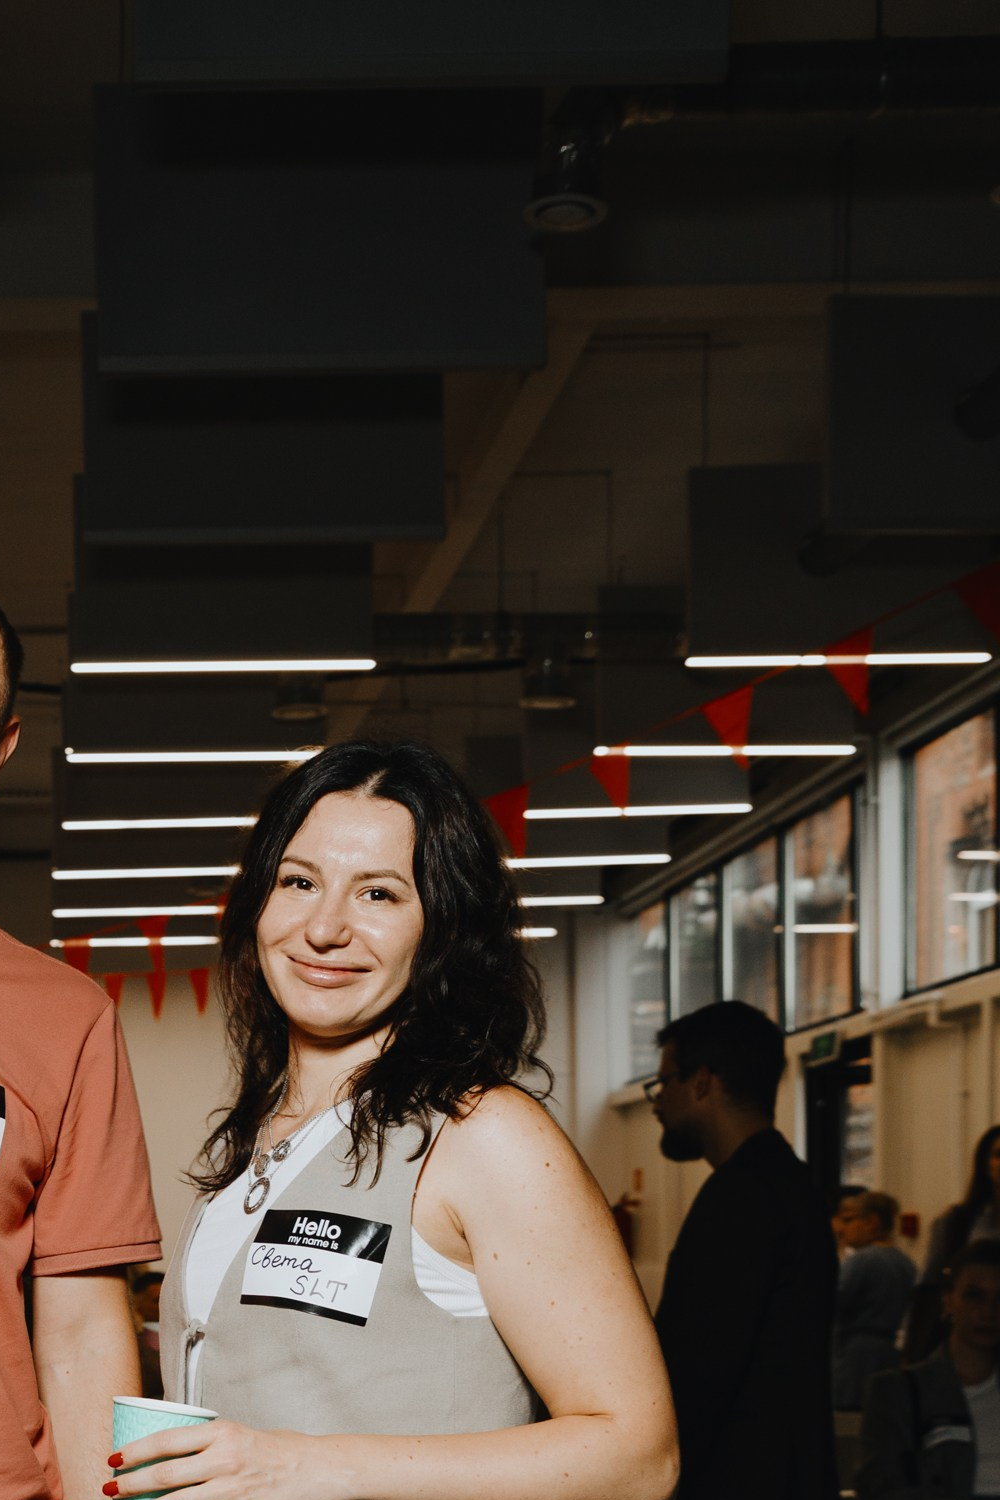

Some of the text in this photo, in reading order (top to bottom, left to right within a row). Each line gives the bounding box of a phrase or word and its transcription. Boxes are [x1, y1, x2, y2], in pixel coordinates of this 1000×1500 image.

[292, 1216, 342, 1240] Hello
[288, 1235, 339, 1250] my name is
[251, 1245, 322, 1274] Света
[290, 1275, 348, 1303] SLT
